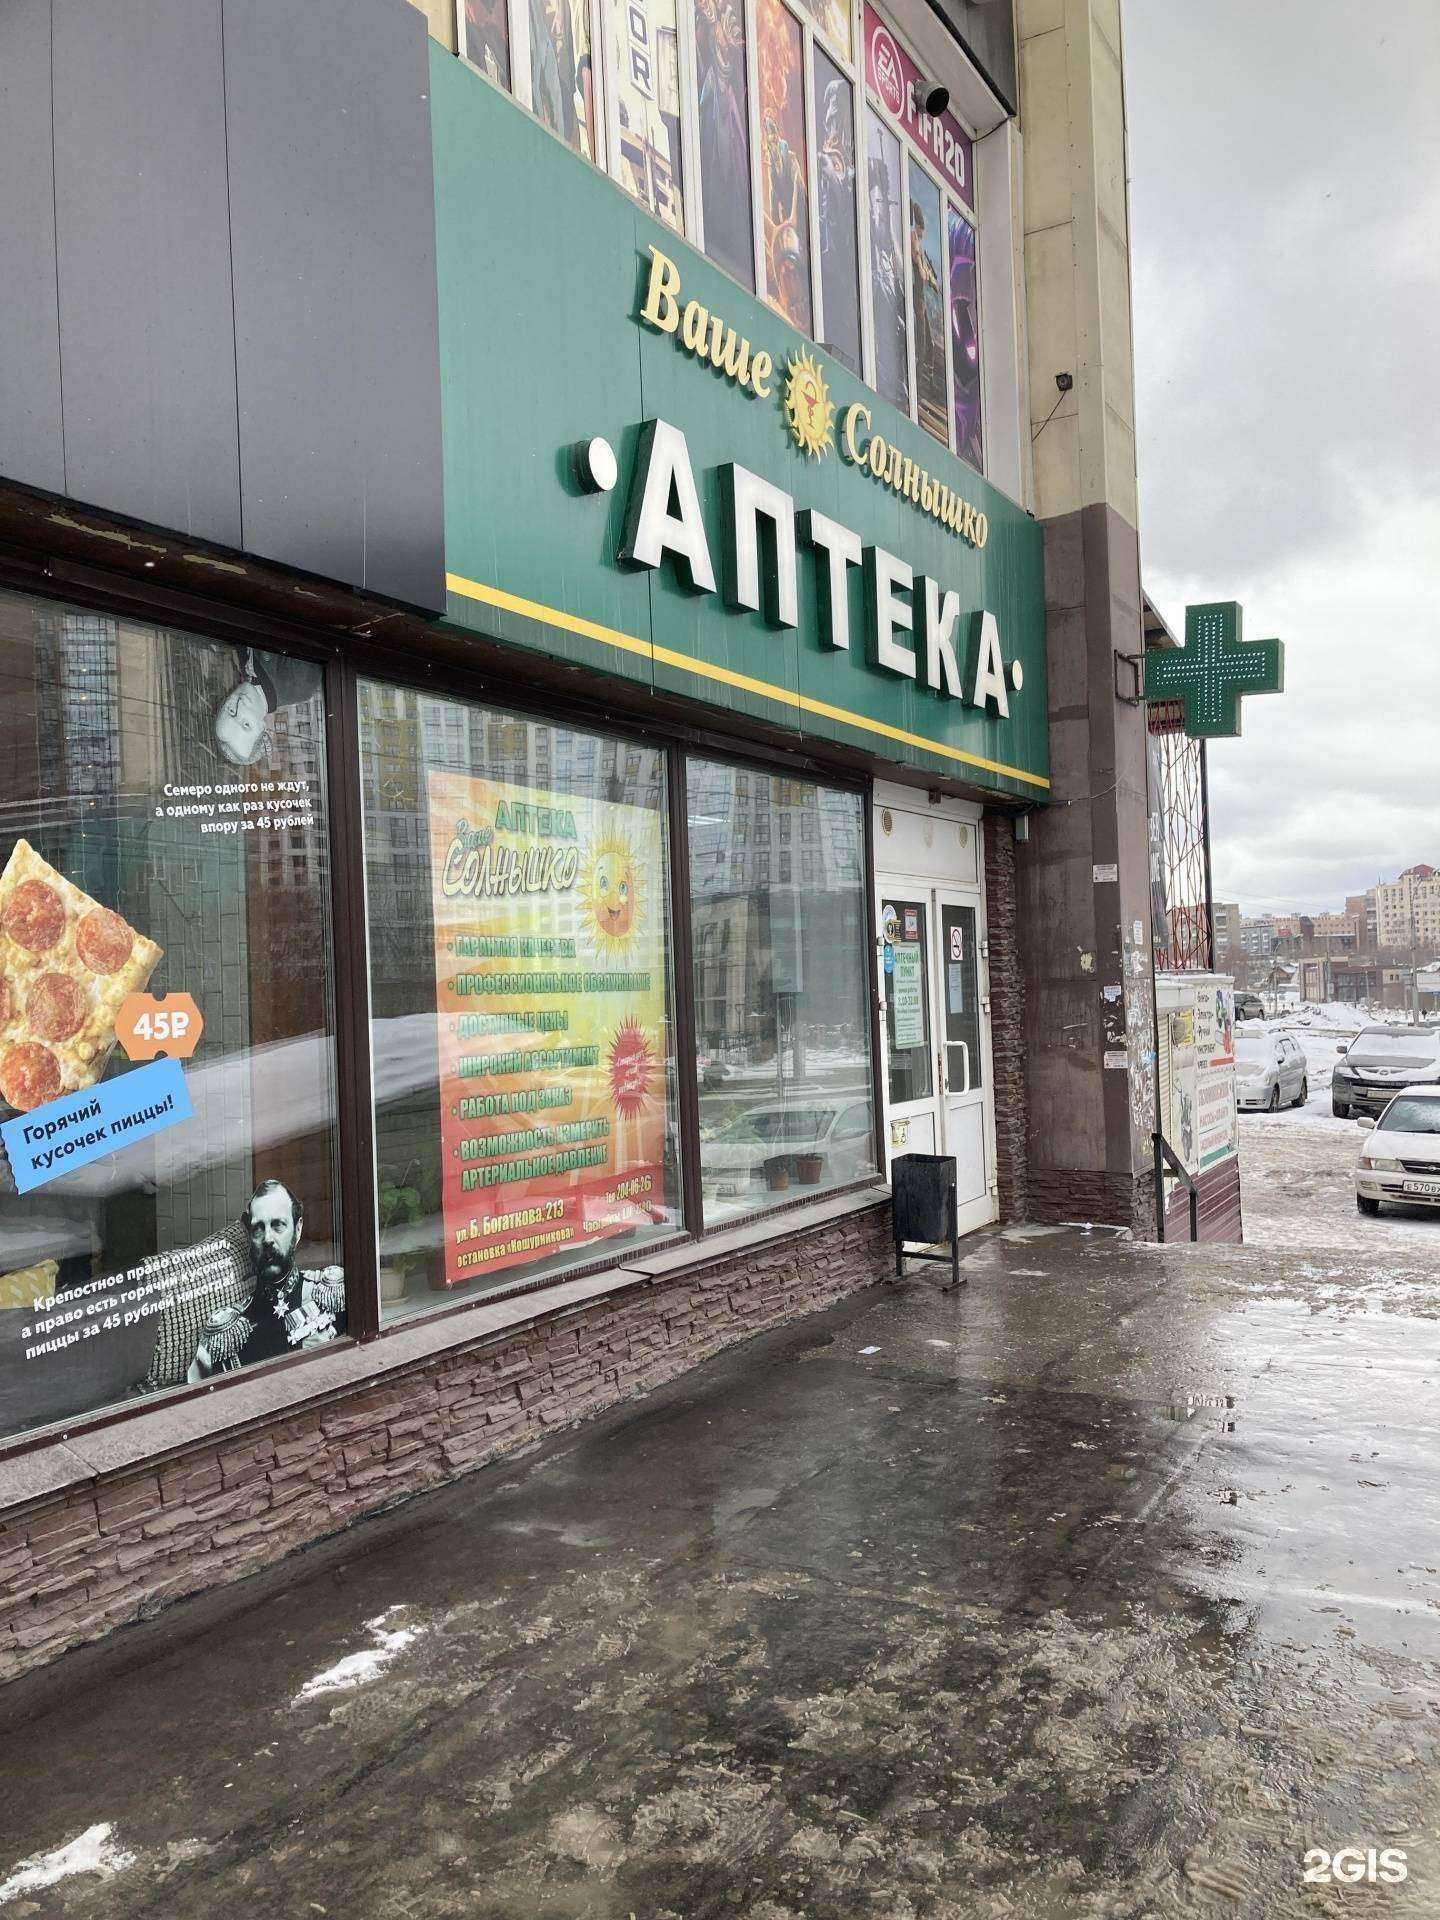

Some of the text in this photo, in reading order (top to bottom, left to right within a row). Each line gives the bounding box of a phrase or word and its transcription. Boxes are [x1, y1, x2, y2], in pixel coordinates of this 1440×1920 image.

[639, 244, 774, 398] Ваше
[845, 402, 988, 549] Солнышко
[624, 418, 1010, 719] АПТЕКА
[155, 798, 312, 817] а одному как раз кусочек
[163, 781, 309, 797] Семеро одного не ждут,
[200, 813, 314, 834] впору за 45 рублей
[495, 800, 577, 839] АПТЕКА
[455, 936, 518, 957] ГАРАНТИЯ
[456, 973, 582, 995] ПРОФЕССИОНАЛЬНОЕ
[536, 1011, 568, 1033] ЦЕНЫ
[459, 1049, 522, 1078] ШИРОКИЙ
[22, 1099, 102, 1144] Горячий
[460, 1086, 572, 1120] РАБОТА ПОД ЗАКАЗ
[31, 1094, 175, 1170] кусочек пиццы!
[460, 1118, 610, 1161] ВОЗМОЖНОСТЬ ИЗМЕРИТЬ
[461, 1144, 608, 1191] АРТЕРИАЛЬНОЕ ДАВЛЕНИЕ
[546, 1199, 564, 1220] 213
[33, 1240, 231, 1312] Крепостное право отменил,
[457, 1245, 506, 1269] остановка
[21, 1257, 234, 1339] а право есть горячий кусочек
[25, 1272, 235, 1360] пиццы за 45 рублей никогда!
